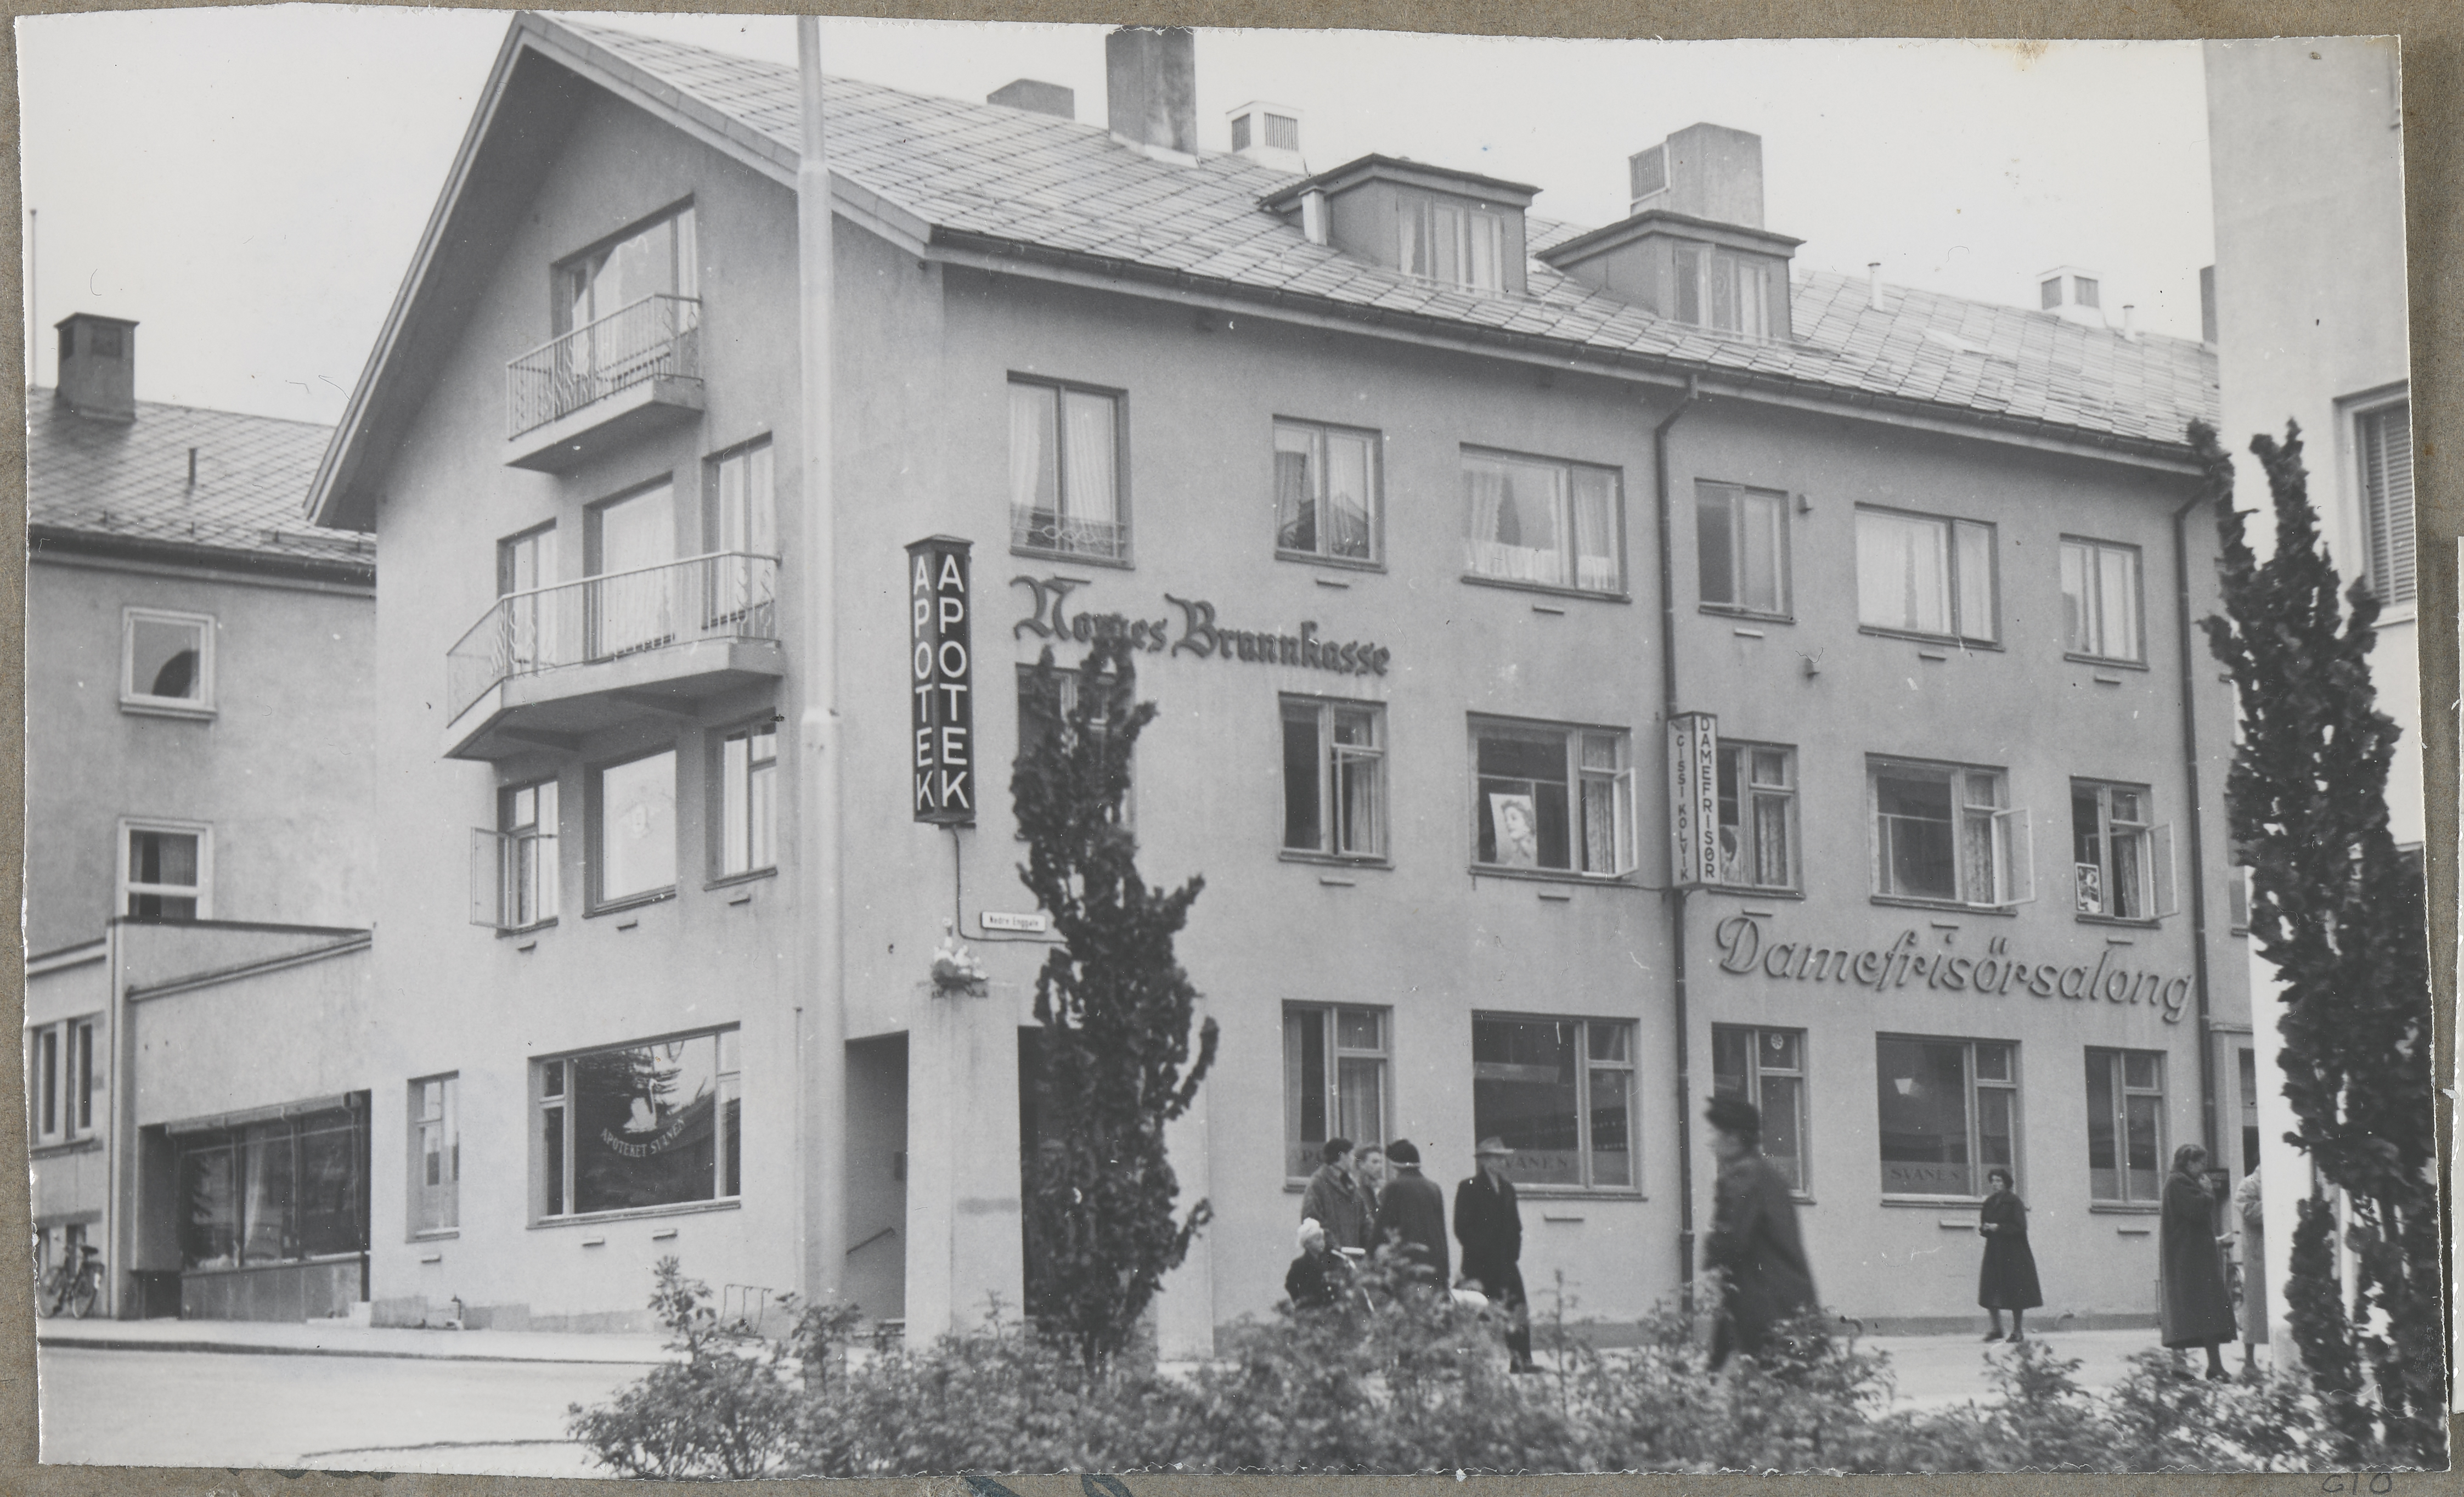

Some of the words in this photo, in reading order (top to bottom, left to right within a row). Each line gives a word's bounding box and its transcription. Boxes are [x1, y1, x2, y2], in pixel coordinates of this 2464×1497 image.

[938, 554, 969, 809] APOTEK
[1164, 593, 1390, 676] Brannkasse
[914, 555, 934, 811] APOTEK
[1677, 734, 1686, 798] CISSI
[1700, 717, 1715, 878] DAMEFRISØR
[1678, 803, 1689, 881] KOLVIK
[1716, 915, 2195, 1023] Damefrisörsalong
[600, 1128, 648, 1157] APOTEKET
[650, 1116, 686, 1155] SVANEN
